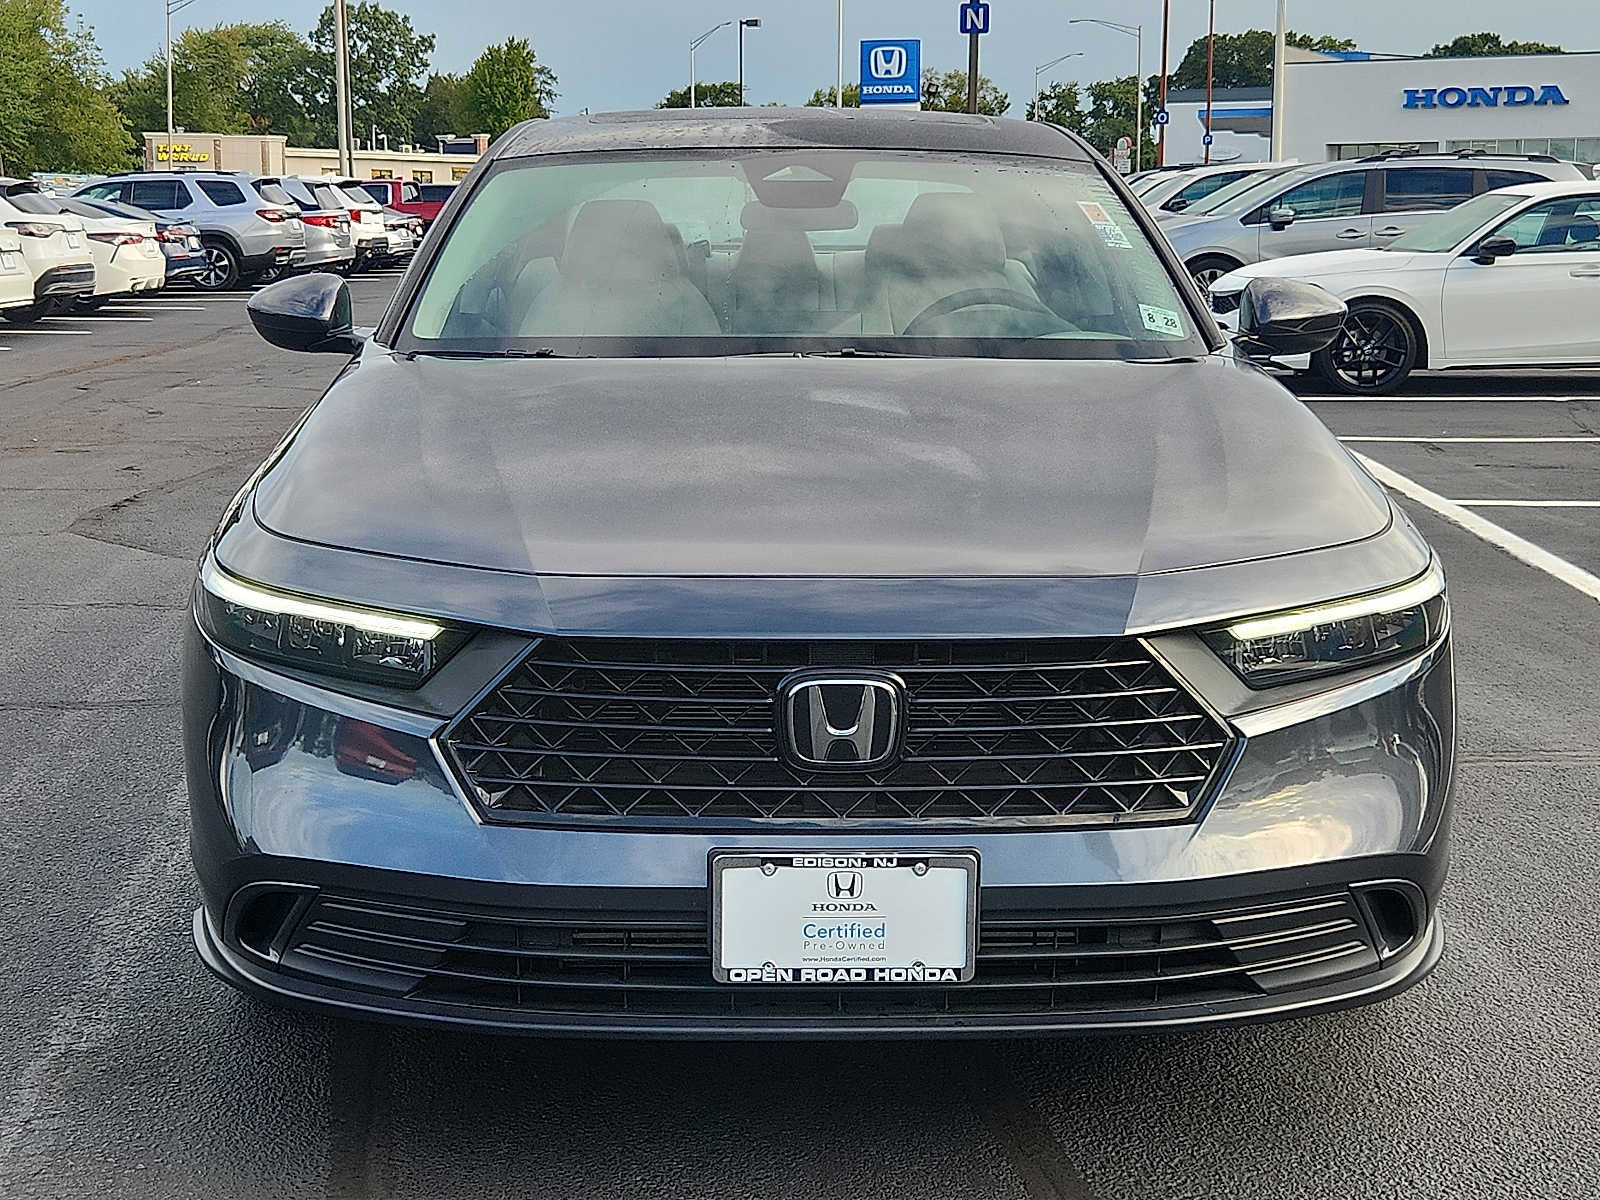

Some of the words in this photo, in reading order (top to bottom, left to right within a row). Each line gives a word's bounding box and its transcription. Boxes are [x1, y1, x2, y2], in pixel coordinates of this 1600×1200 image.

[966, 7, 984, 30] N
[862, 85, 914, 95] HONDA
[1402, 85, 1570, 109] HONDA
[157, 152, 210, 162] WORLD
[1147, 313, 1155, 323] 8
[1163, 316, 1177, 328] 28
[792, 857, 867, 869] EDISON,
[873, 857, 898, 868] NJ
[811, 903, 877, 912] HONDA
[802, 922, 886, 939] Certified
[803, 940, 885, 950] Pre-Owned
[802, 955, 887, 963] www.HondaCertified.com
[729, 968, 793, 982] OPEN
[801, 968, 867, 982] ROAD
[874, 968, 958, 982] HONDA
